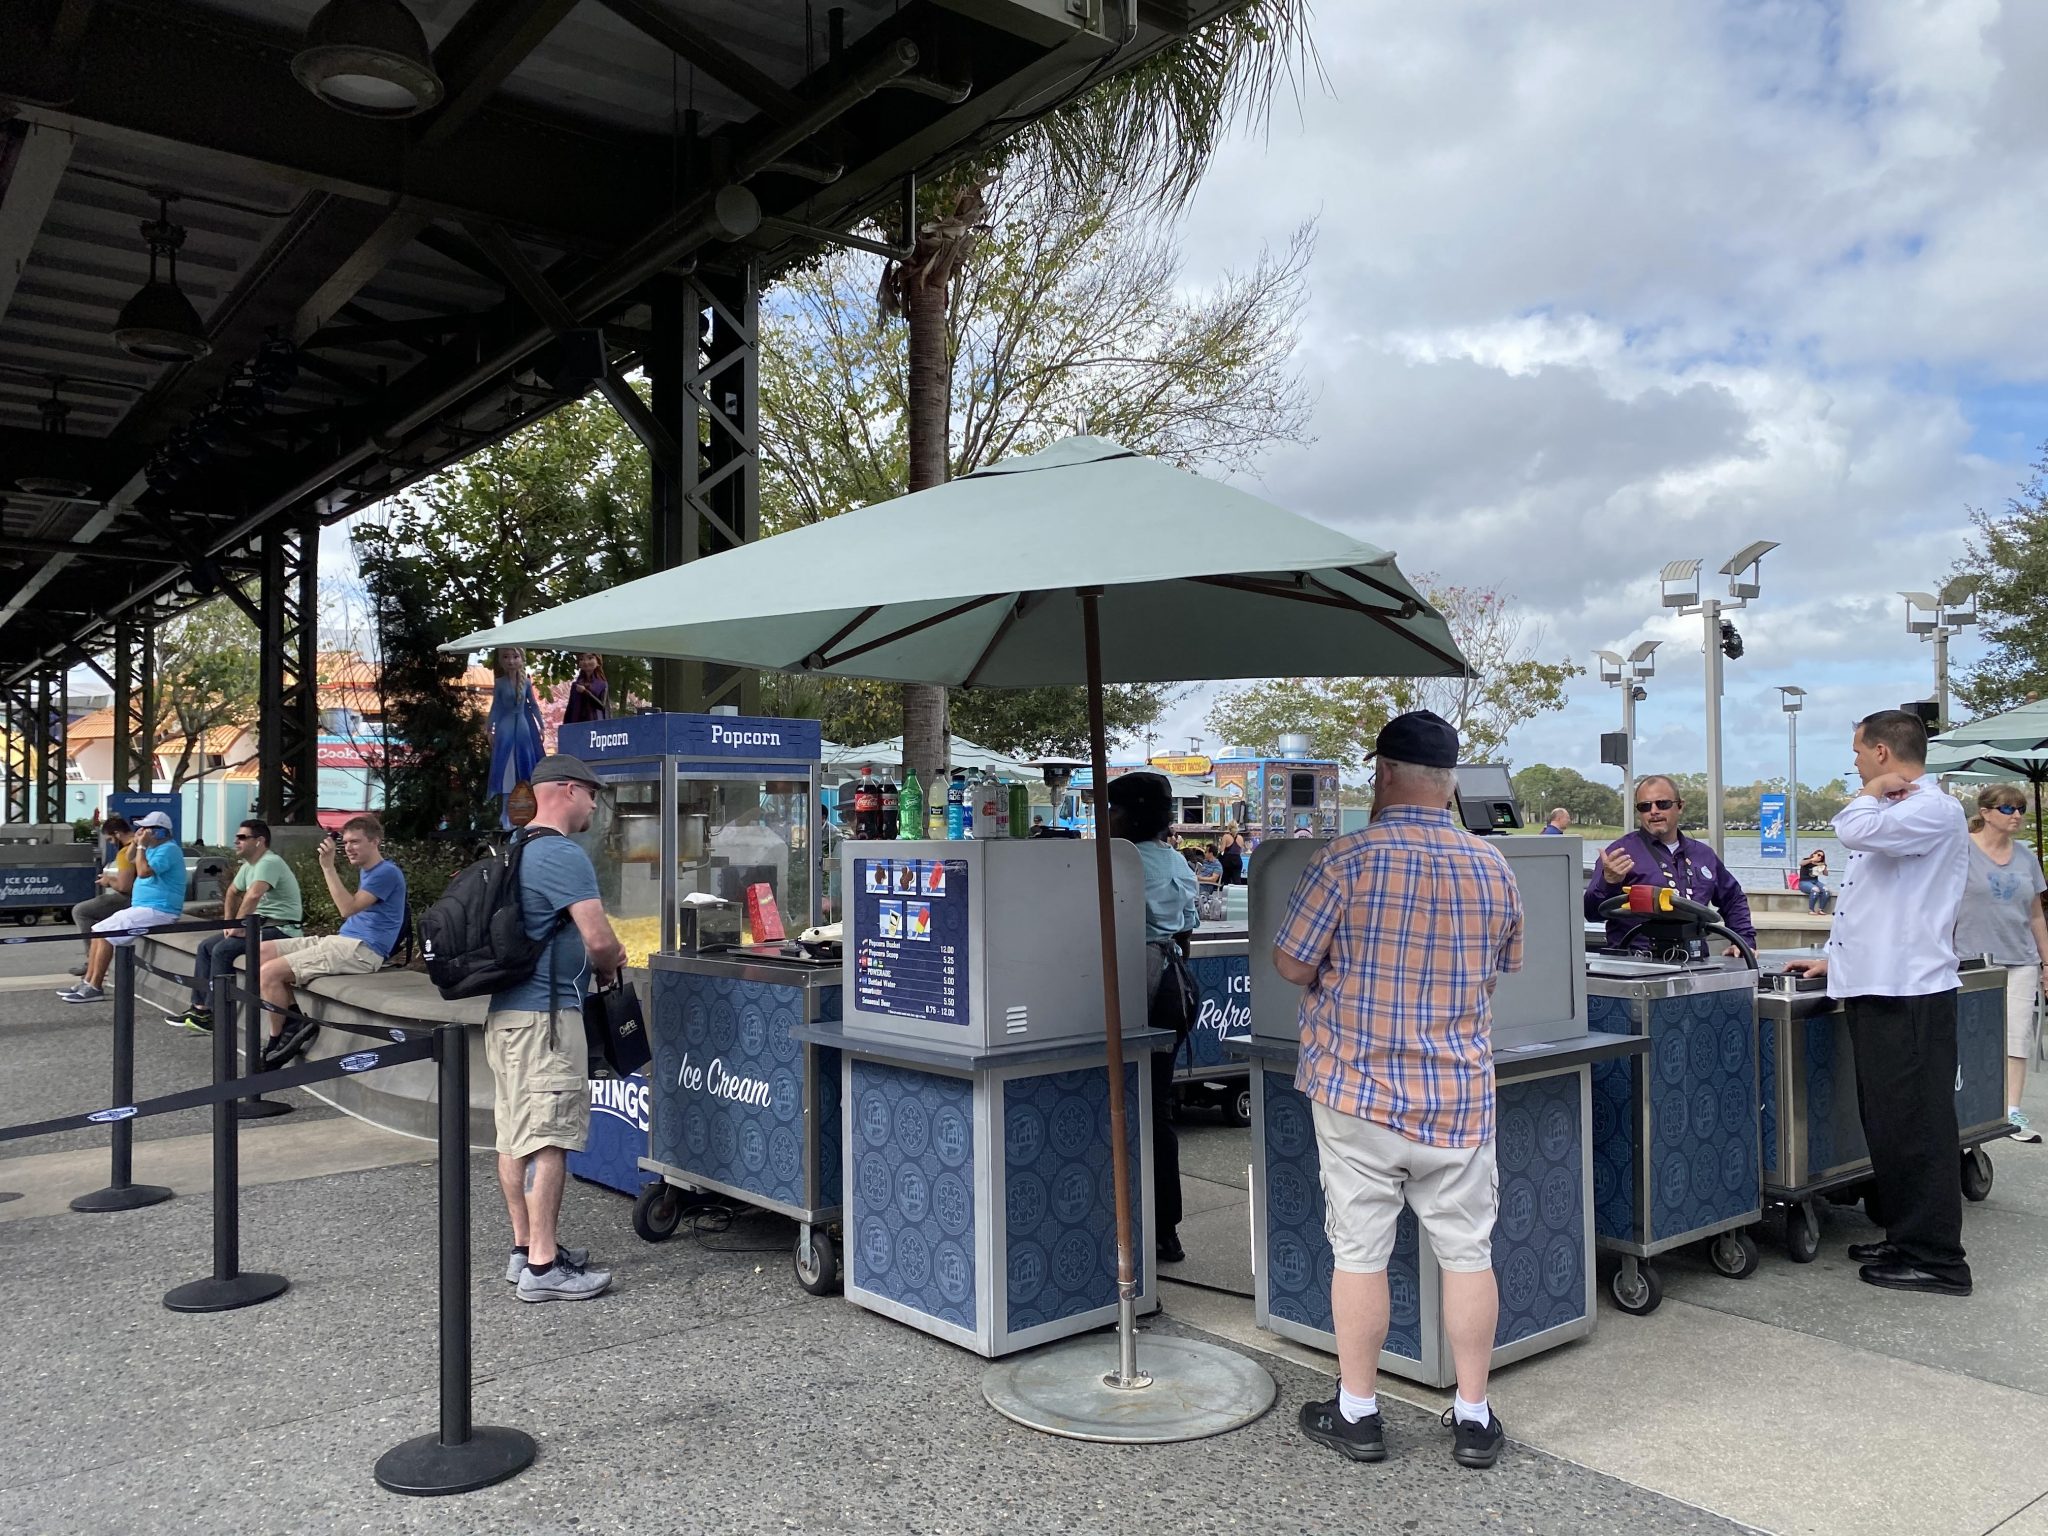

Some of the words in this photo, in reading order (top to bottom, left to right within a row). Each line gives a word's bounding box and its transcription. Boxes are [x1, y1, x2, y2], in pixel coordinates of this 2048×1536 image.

[589, 730, 629, 751] Popcorn
[711, 725, 781, 748] Popcorn
[24, 876, 48, 884] COLD
[943, 956, 954, 965] 5.25
[943, 966, 954, 975] 4.50
[944, 976, 954, 985] 5.00
[1227, 975, 1250, 993] ICE
[944, 987, 954, 996] 3.50
[944, 997, 954, 1006] 5.50
[941, 1007, 954, 1017] 12.00
[1197, 997, 1251, 1041] Refre
[678, 1052, 702, 1091] Ice
[707, 1058, 771, 1107] Cream
[588, 1079, 649, 1132] RINGS
